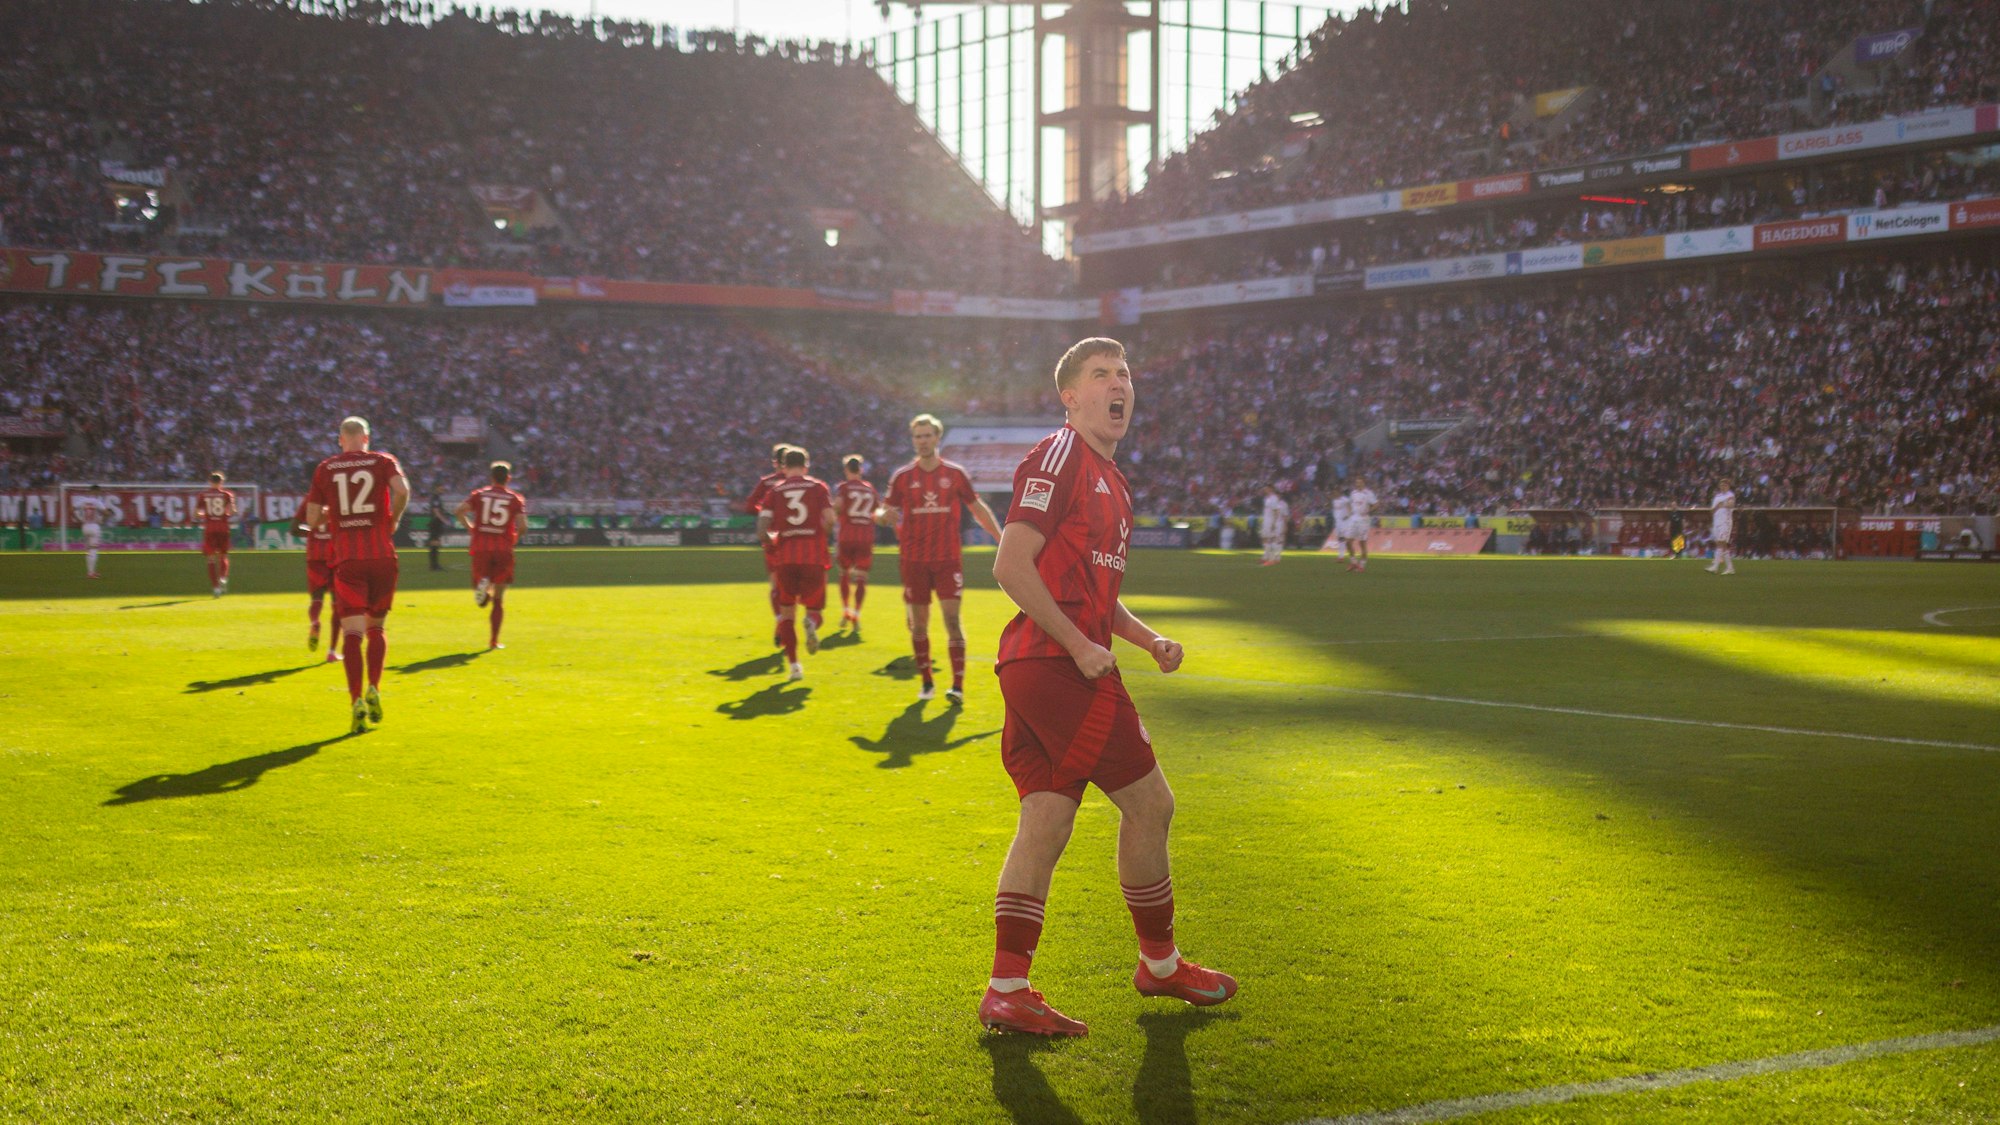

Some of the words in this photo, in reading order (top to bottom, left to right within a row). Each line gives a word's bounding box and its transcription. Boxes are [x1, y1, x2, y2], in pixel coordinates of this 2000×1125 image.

[1784, 130, 1864, 155] CARGLASS
[1761, 222, 1840, 244] HAGEDORN
[1875, 213, 1941, 231] NetCologne
[332, 470, 376, 516] 12
[847, 491, 875, 519] 22
[203, 496, 225, 517] 18
[480, 497, 511, 527] 15
[783, 489, 809, 526] 3
